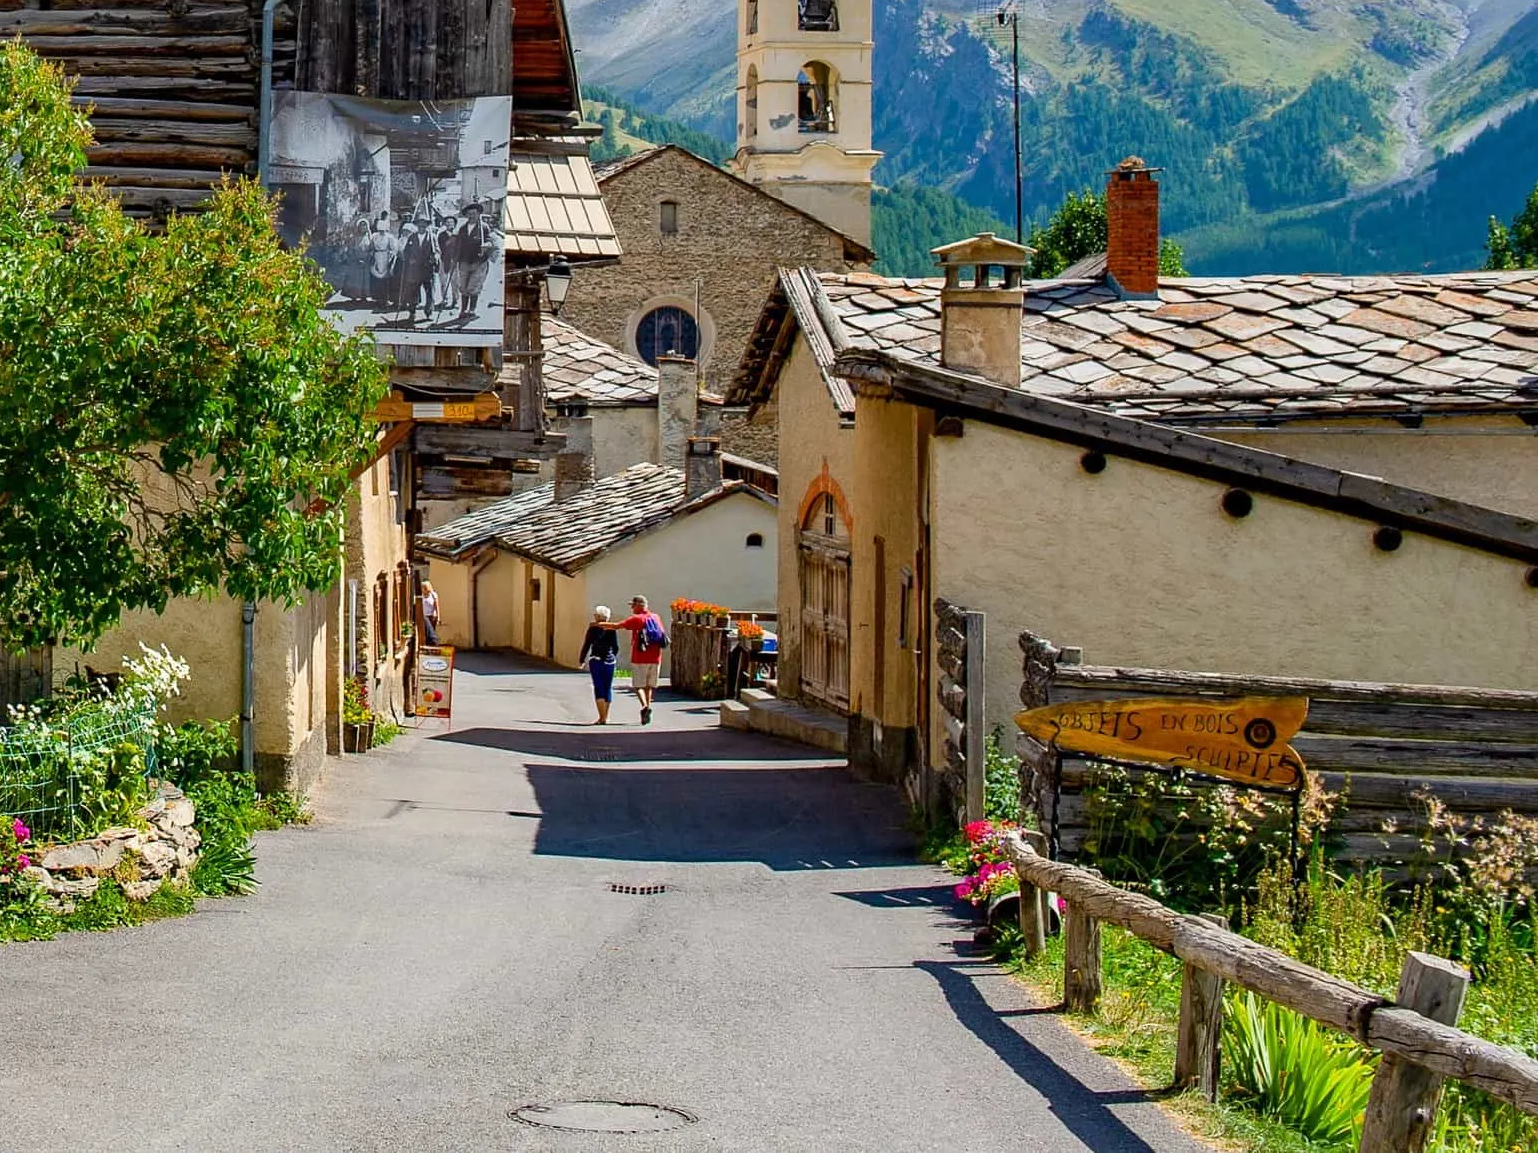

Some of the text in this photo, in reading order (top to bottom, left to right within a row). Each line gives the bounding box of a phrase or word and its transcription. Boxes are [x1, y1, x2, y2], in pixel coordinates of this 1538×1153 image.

[1058, 710, 1240, 741] OBJETS EN BOIS
